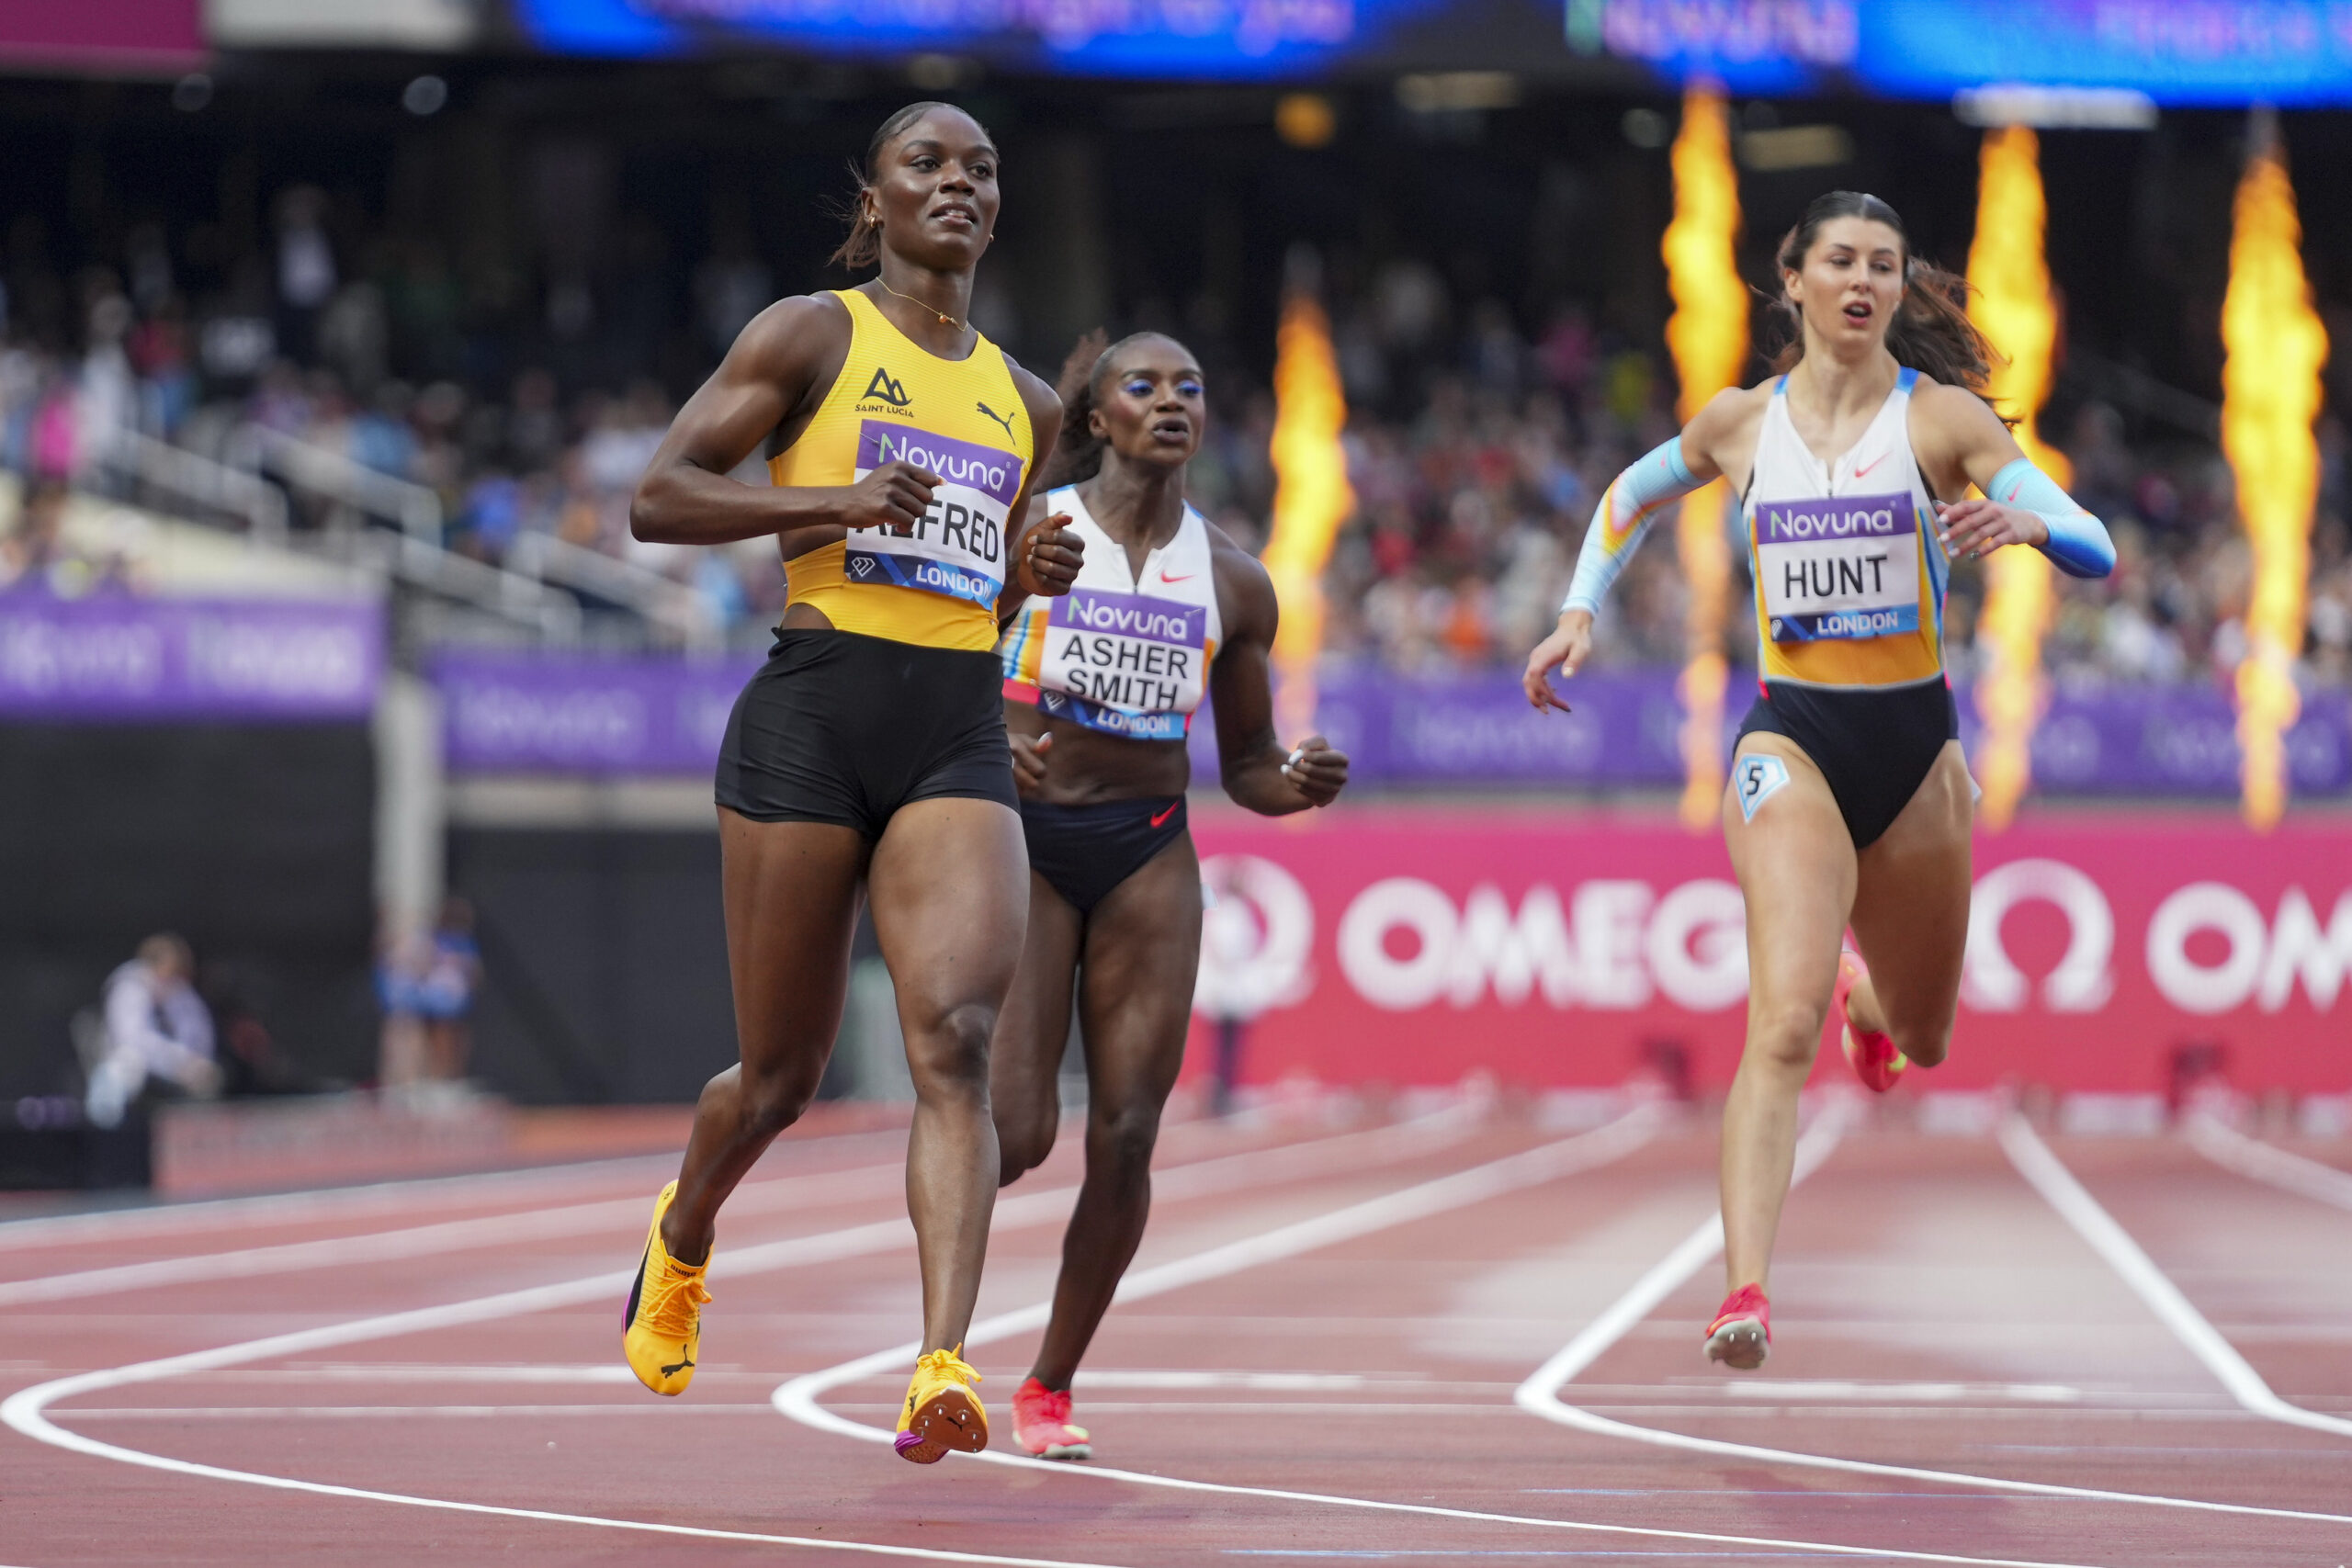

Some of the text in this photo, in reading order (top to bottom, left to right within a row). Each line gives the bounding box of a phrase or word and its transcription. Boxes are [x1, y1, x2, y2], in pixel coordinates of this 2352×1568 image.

[855, 404, 914, 418] SAINT LUCIA
[878, 433, 1006, 492] Novuna
[855, 499, 999, 563] FRED
[1770, 508, 1894, 538] Novuna
[916, 564, 992, 599] LONDON
[1785, 553, 1887, 598] HUNT
[1067, 595, 1188, 641] Novuna
[1816, 611, 1899, 636] LONDON
[1060, 634, 1188, 680] ASHER
[1066, 669, 1179, 710] SMITH
[1096, 707, 1171, 733] LONDON
[1747, 764, 1763, 795] 5
[1337, 877, 1751, 1011] OMEG
